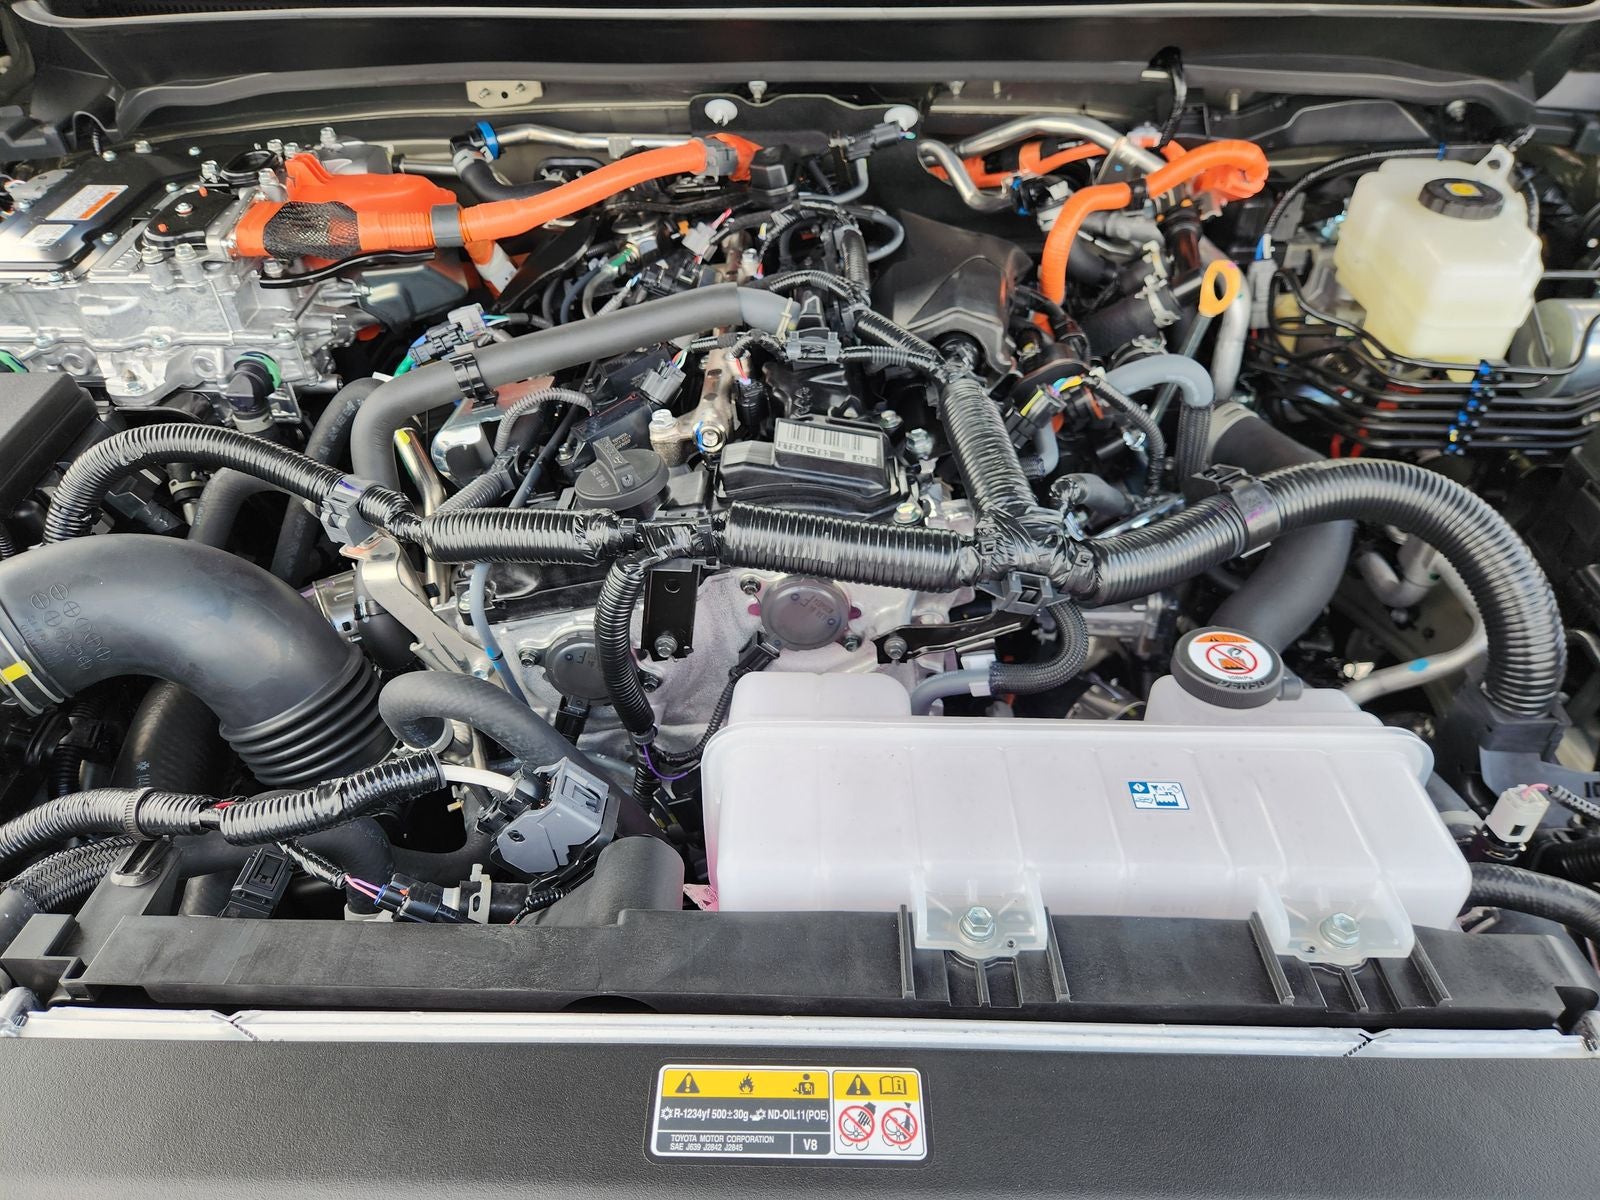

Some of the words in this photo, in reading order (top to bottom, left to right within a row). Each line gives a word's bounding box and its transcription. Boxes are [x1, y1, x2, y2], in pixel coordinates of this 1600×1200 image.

[673, 1108, 710, 1121] R-1234yf
[711, 1109, 749, 1121] 500±30g
[767, 1110, 829, 1122] ND-OIL11(POE)
[670, 1134, 697, 1142] TOYOTA
[726, 1135, 775, 1144] CORPORATION
[803, 1138, 818, 1151] V8
